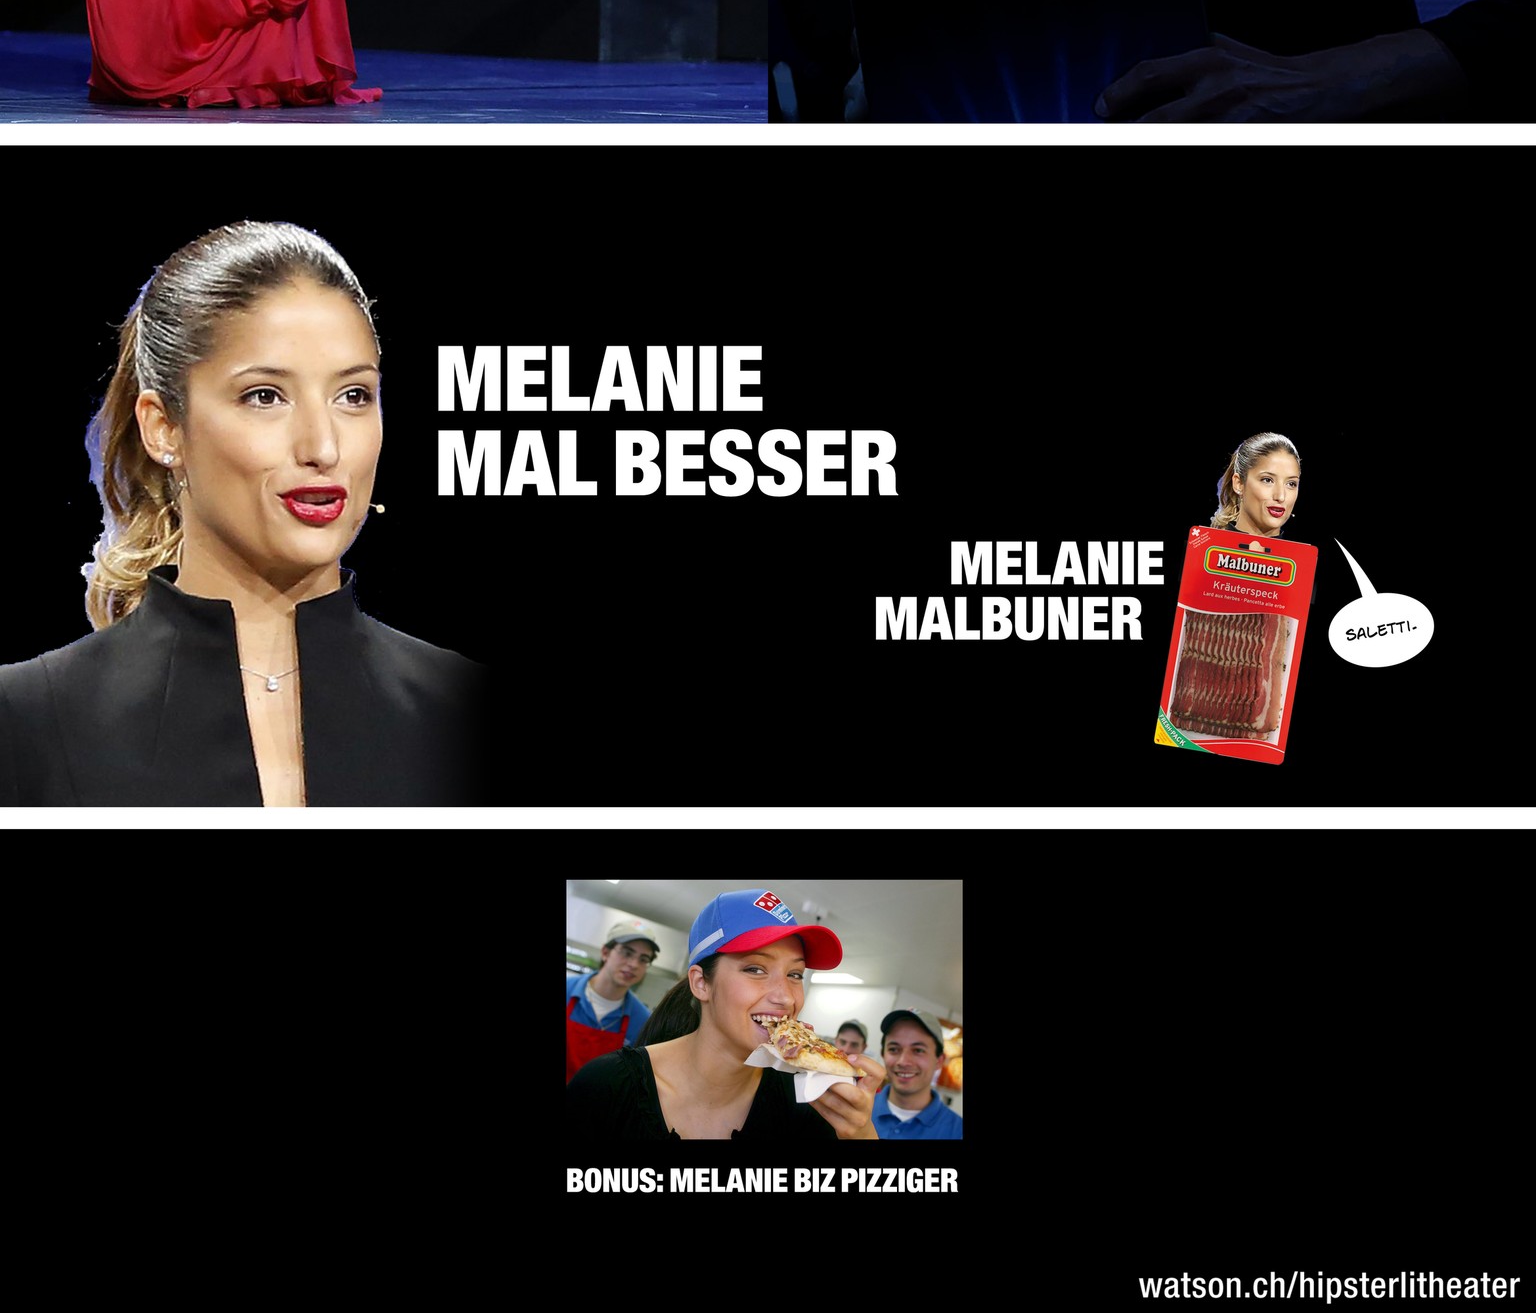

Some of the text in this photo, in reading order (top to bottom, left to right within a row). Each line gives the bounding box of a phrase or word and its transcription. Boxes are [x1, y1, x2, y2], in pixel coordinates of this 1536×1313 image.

[1216, 553, 1282, 577] Malbuner
[1212, 581, 1278, 600] Kräuterspeck
[1223, 594, 1241, 602] herbes
[1243, 597, 1265, 606] Pancetta
